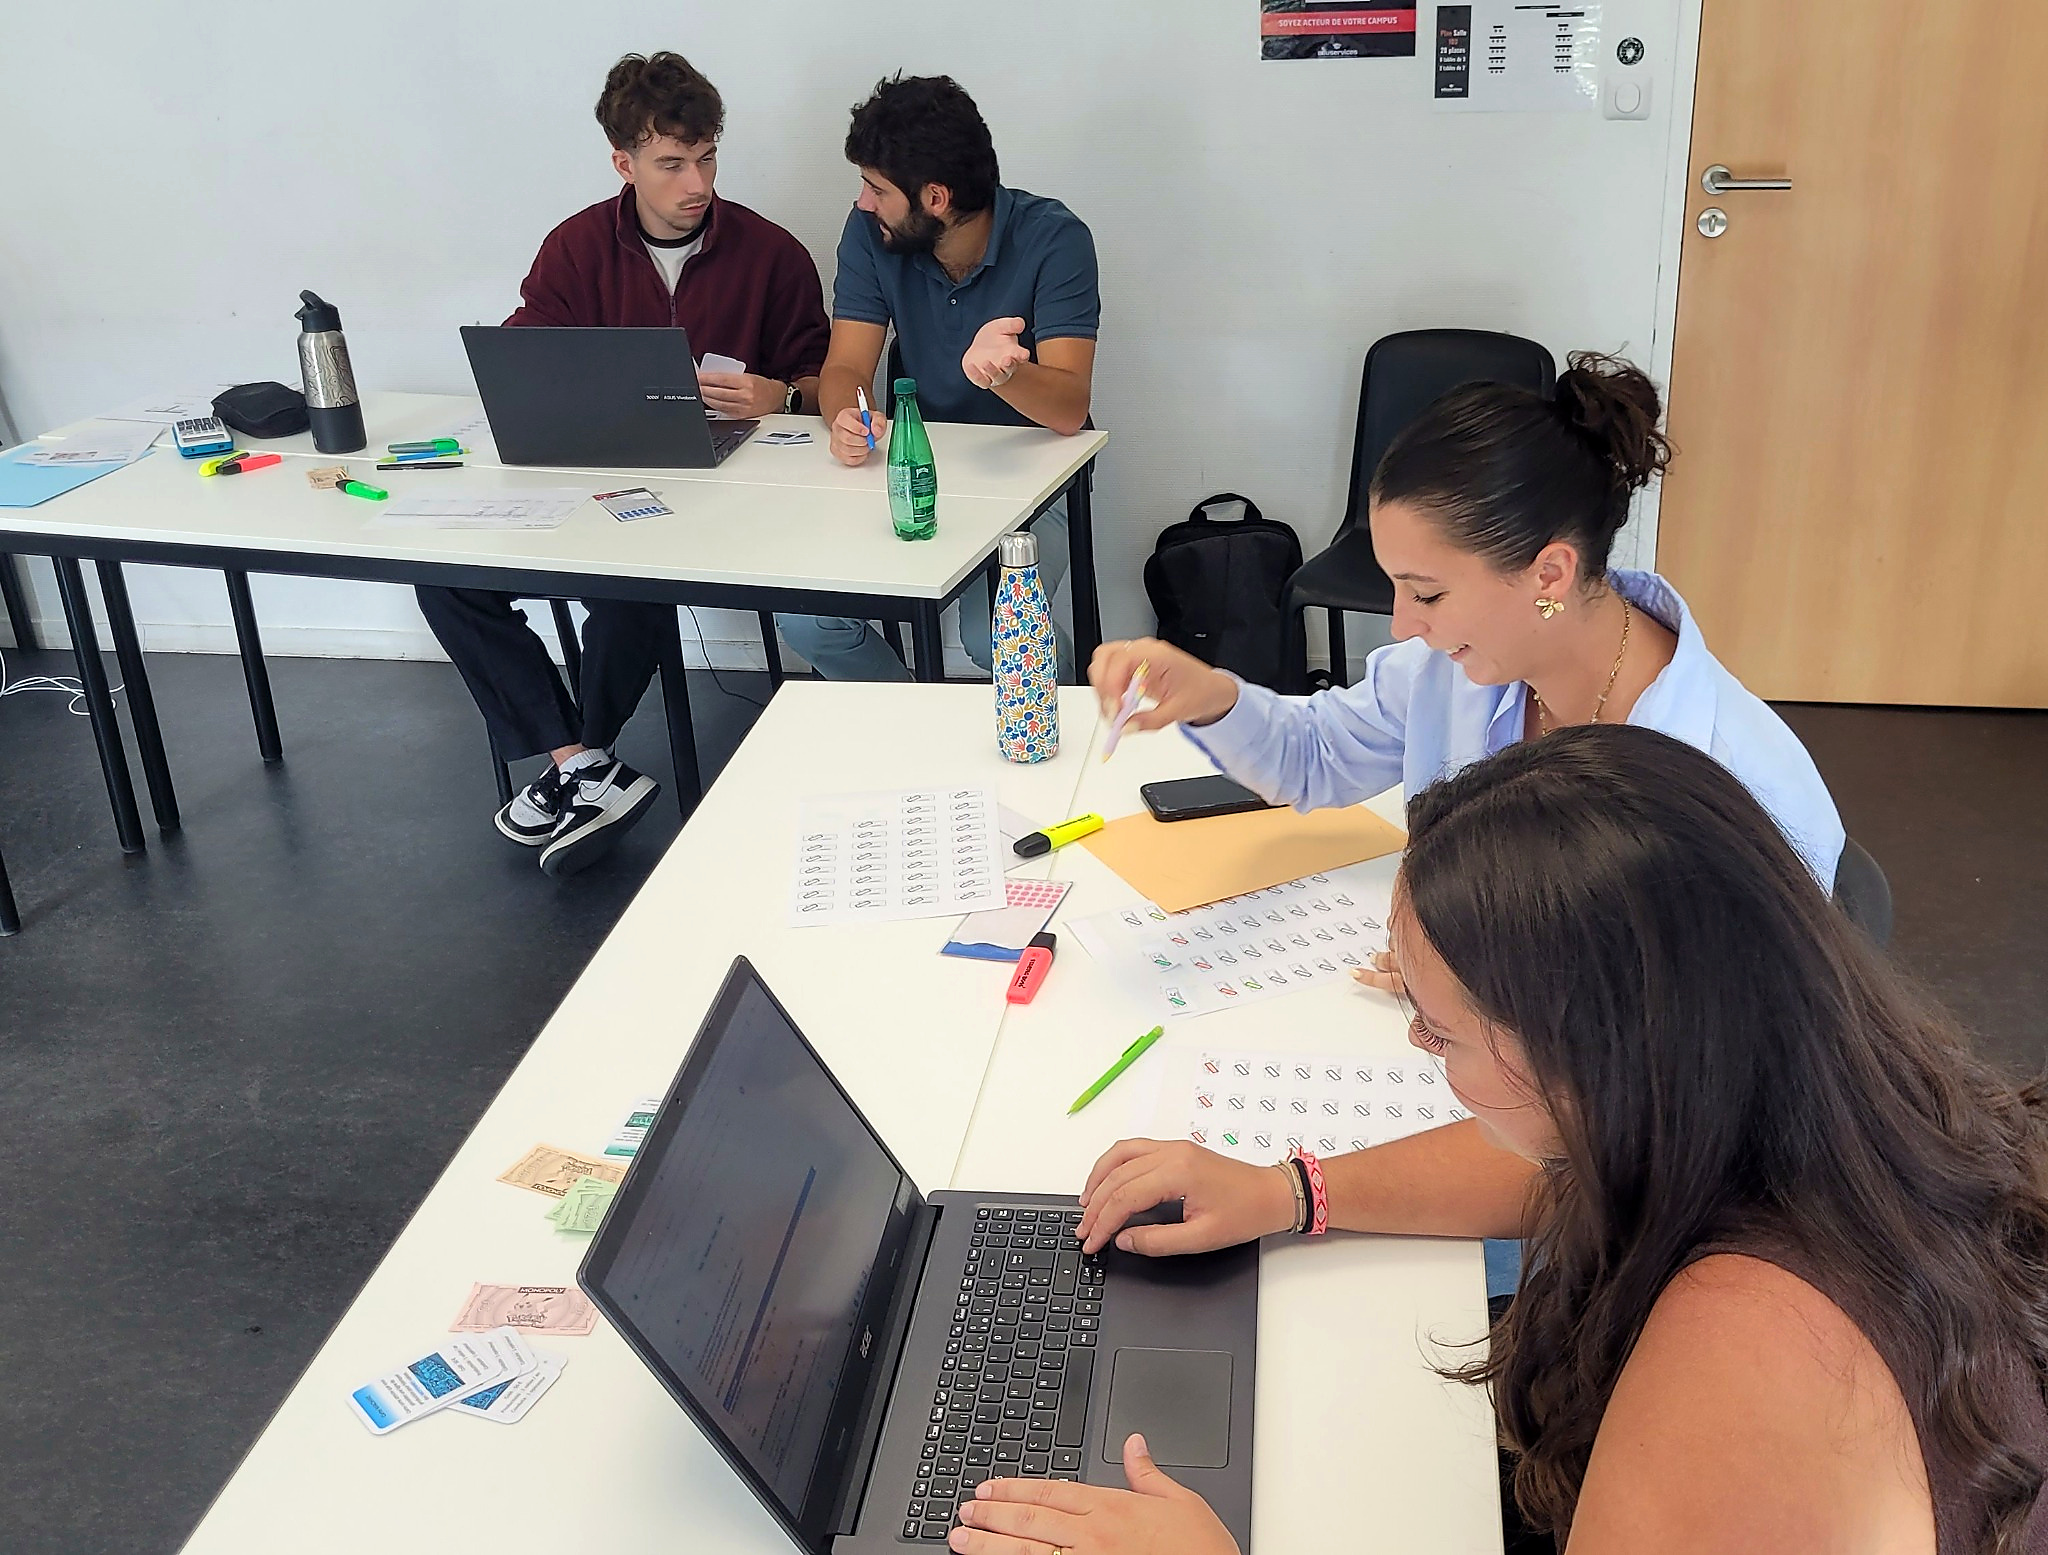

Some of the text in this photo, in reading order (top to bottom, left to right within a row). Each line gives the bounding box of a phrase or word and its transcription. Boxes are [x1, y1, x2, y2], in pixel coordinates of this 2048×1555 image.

[1278, 19, 1301, 27] SOYEZ
[1303, 18, 1330, 26] ACTEUR
[1343, 17, 1366, 25] VOTRE
[1368, 16, 1398, 24] CAMPUS
[859, 1324, 873, 1359] acer
